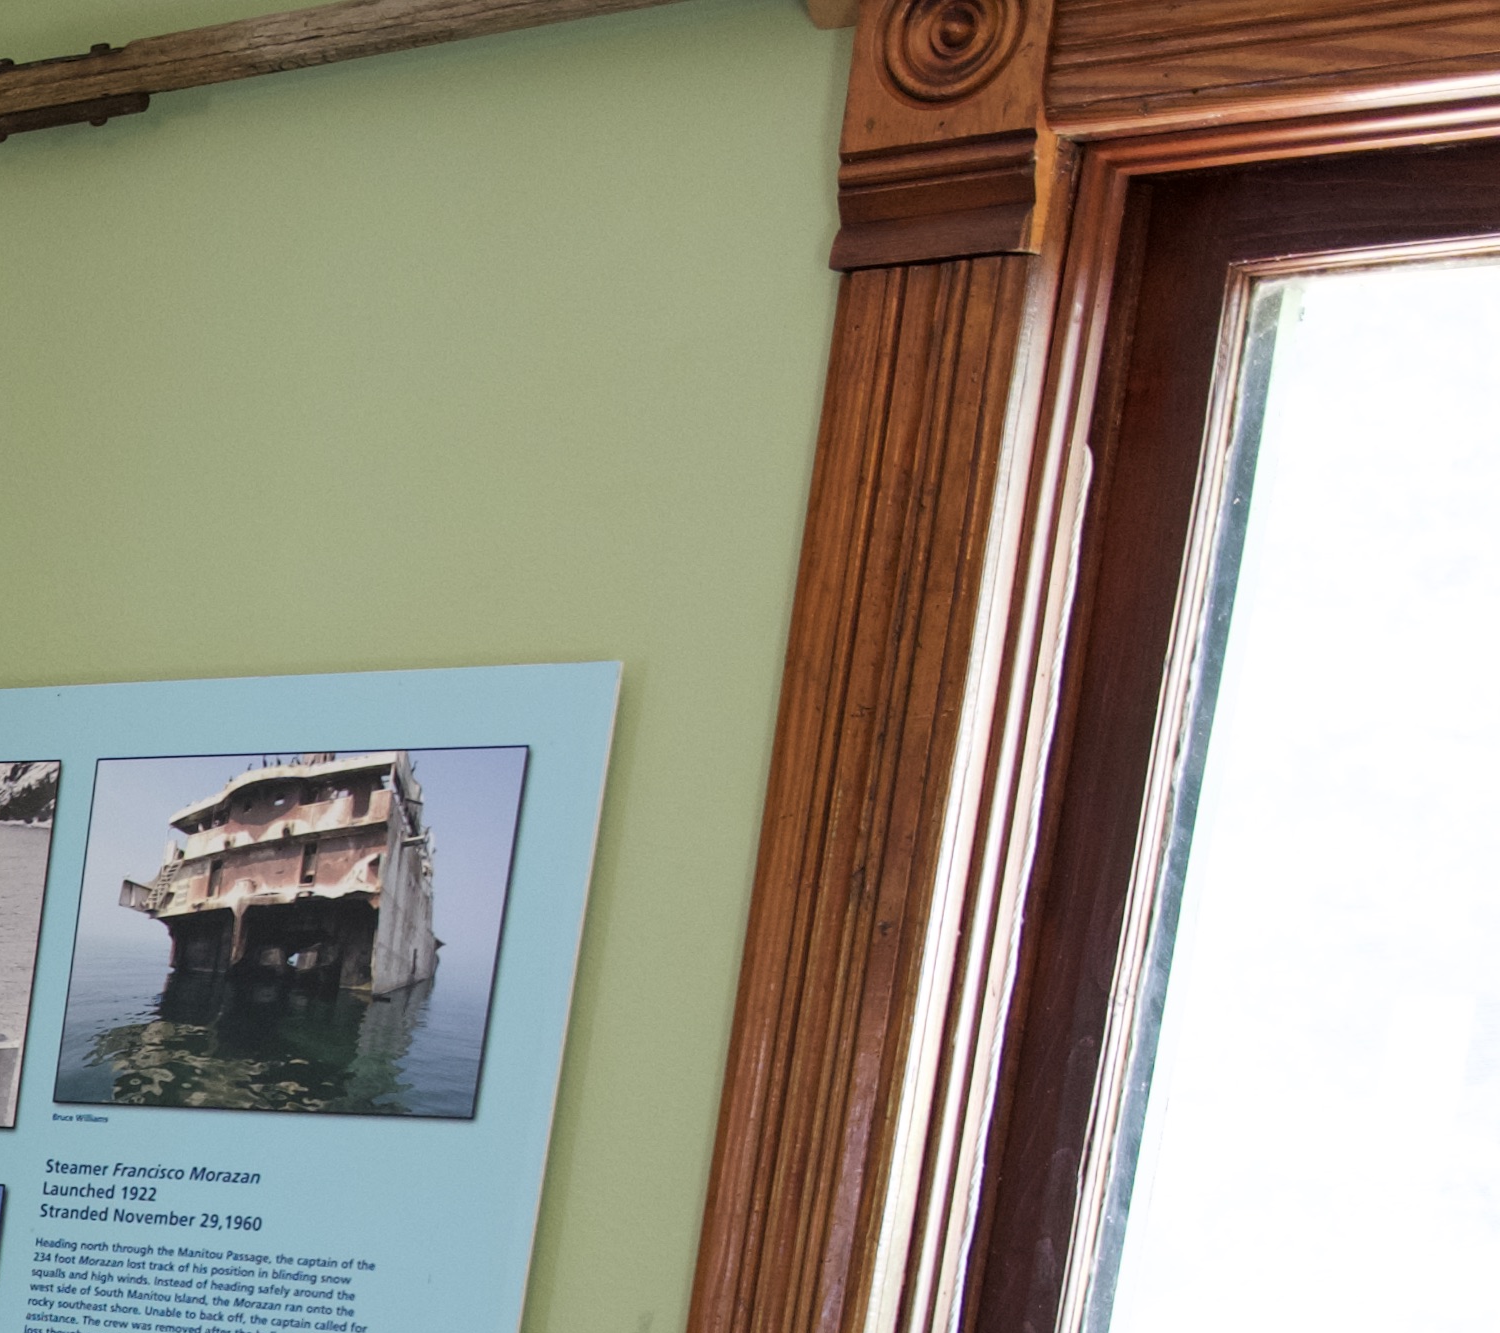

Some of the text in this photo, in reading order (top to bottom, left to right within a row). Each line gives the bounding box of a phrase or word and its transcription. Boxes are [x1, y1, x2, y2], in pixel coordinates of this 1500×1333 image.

[45, 1158, 261, 1185] Steamer Francisco Morazan
[42, 1181, 157, 1202] Launched 1922
[39, 1203, 109, 1222] Stranded
[113, 1208, 196, 1227] November
